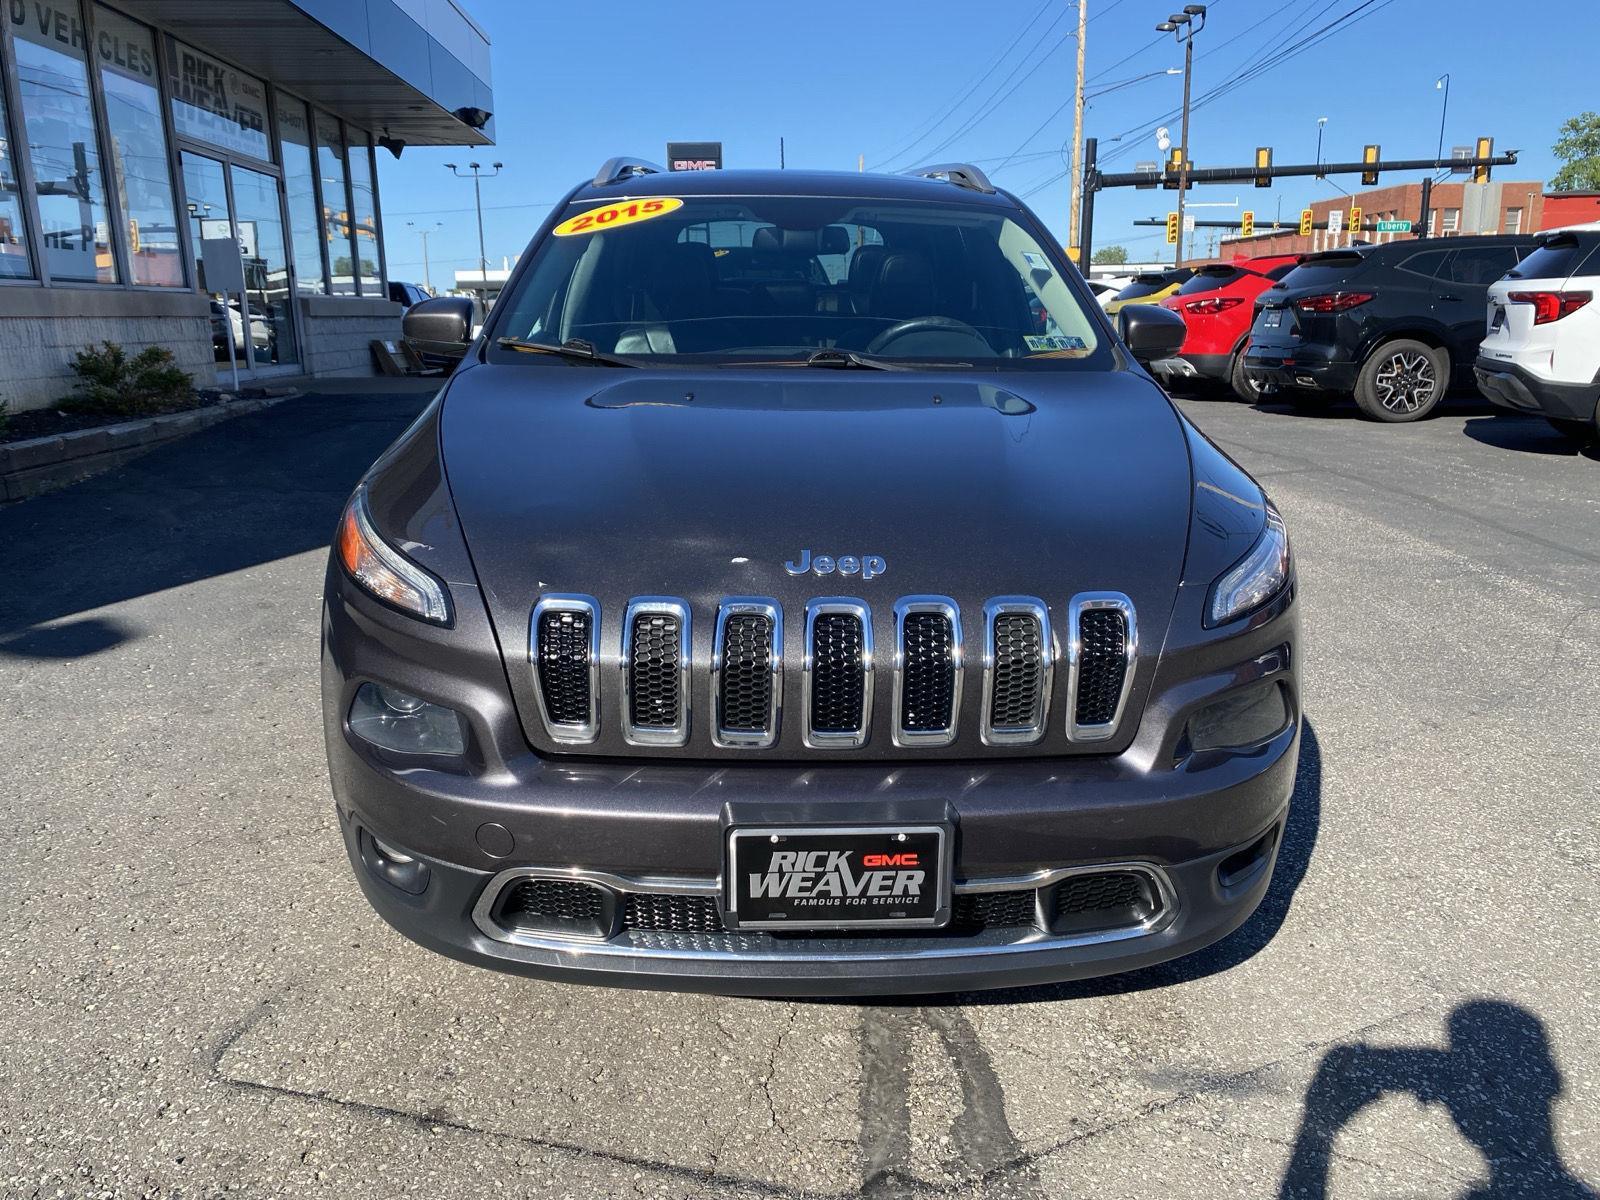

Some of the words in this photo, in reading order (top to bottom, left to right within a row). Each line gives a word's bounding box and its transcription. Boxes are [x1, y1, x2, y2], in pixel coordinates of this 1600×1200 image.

[673, 160, 717, 171] GMC
[570, 200, 666, 232] 2015
[1381, 222, 1407, 231] Liberty
[784, 549, 887, 580] Jeep
[767, 850, 854, 873] RICK
[863, 853, 919, 867] GMC
[749, 870, 926, 899] WEAVER
[793, 898, 840, 906] FAMOUS
[872, 896, 920, 905] SERVICE
